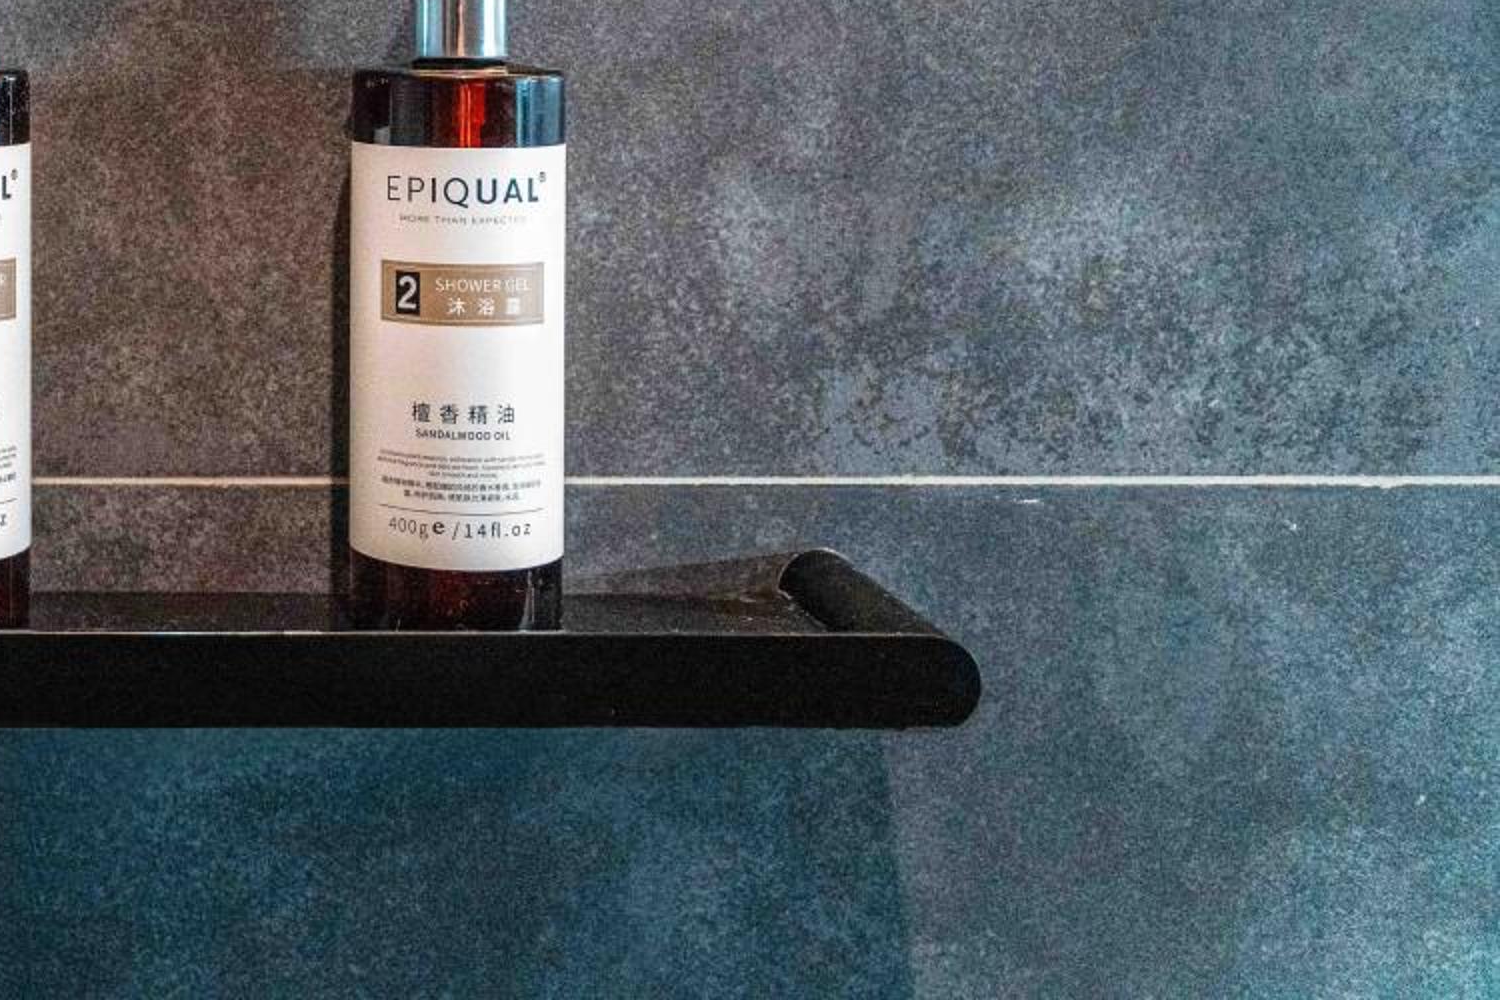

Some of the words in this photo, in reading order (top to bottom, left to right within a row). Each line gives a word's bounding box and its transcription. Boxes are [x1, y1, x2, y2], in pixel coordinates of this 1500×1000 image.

[397, 275, 417, 310] 2
[435, 277, 501, 293] SHOWER
[505, 277, 531, 292] GEL
[412, 402, 515, 425] 檀香精油
